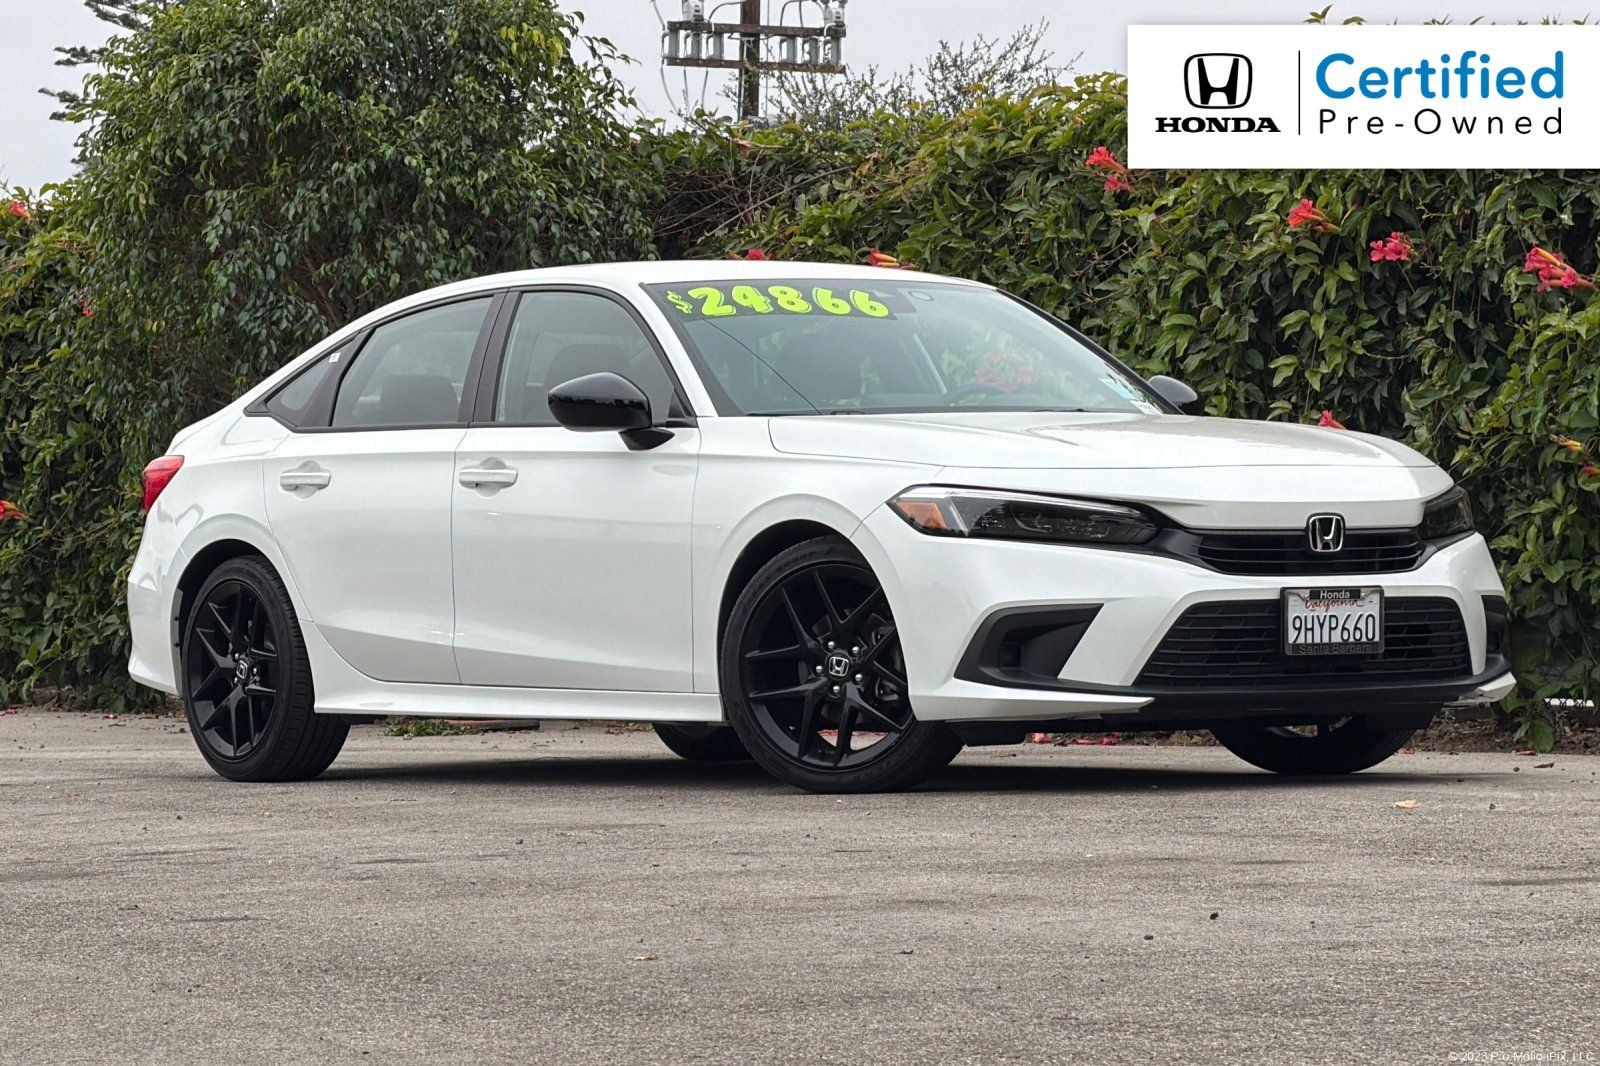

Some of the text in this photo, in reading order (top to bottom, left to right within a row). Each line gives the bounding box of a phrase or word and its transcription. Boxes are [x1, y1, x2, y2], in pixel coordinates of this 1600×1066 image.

[667, 285, 889, 317] $24866
[1320, 590, 1350, 599] Honda
[1292, 613, 1376, 643] 9HYP660
[1299, 644, 1372, 655] Santa Barbara
